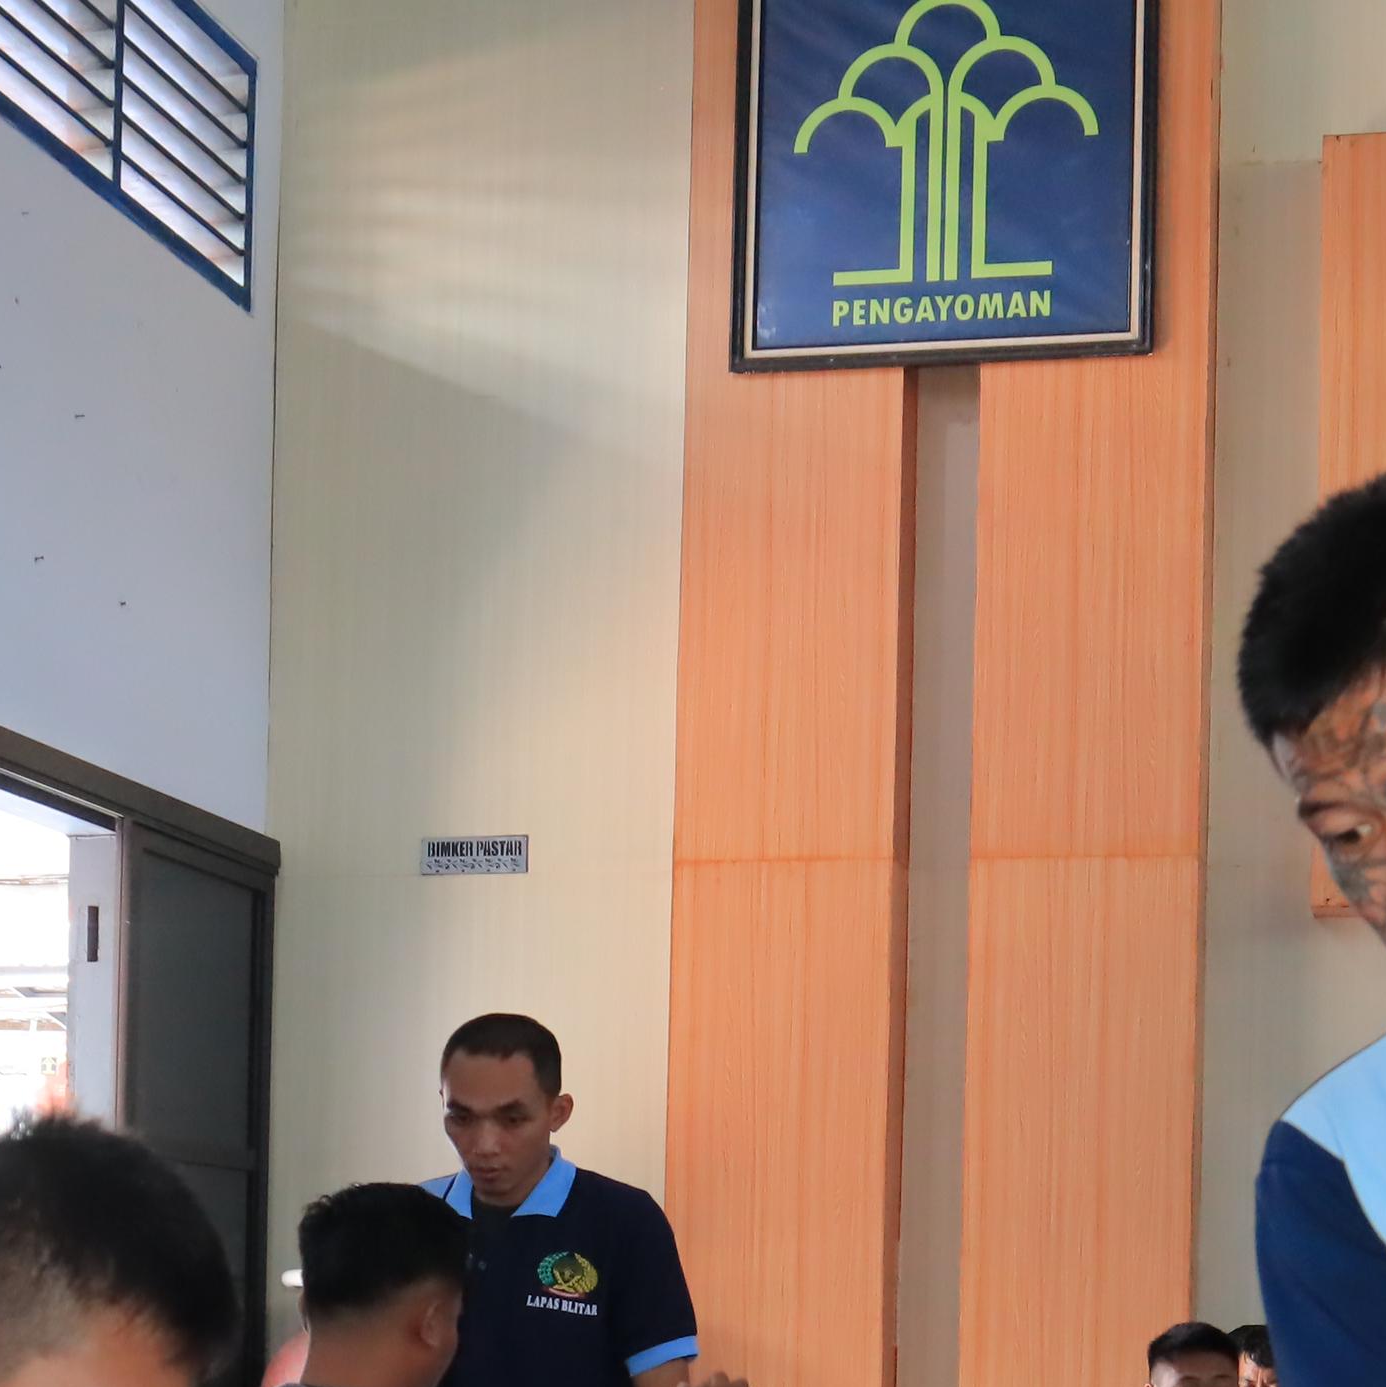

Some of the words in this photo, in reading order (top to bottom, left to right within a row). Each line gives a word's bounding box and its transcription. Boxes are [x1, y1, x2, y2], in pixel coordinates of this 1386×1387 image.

[832, 290, 1052, 327] PENGAYOMAN
[526, 1294, 560, 1310] LAPAS
[561, 1299, 598, 1316] BLITAR
